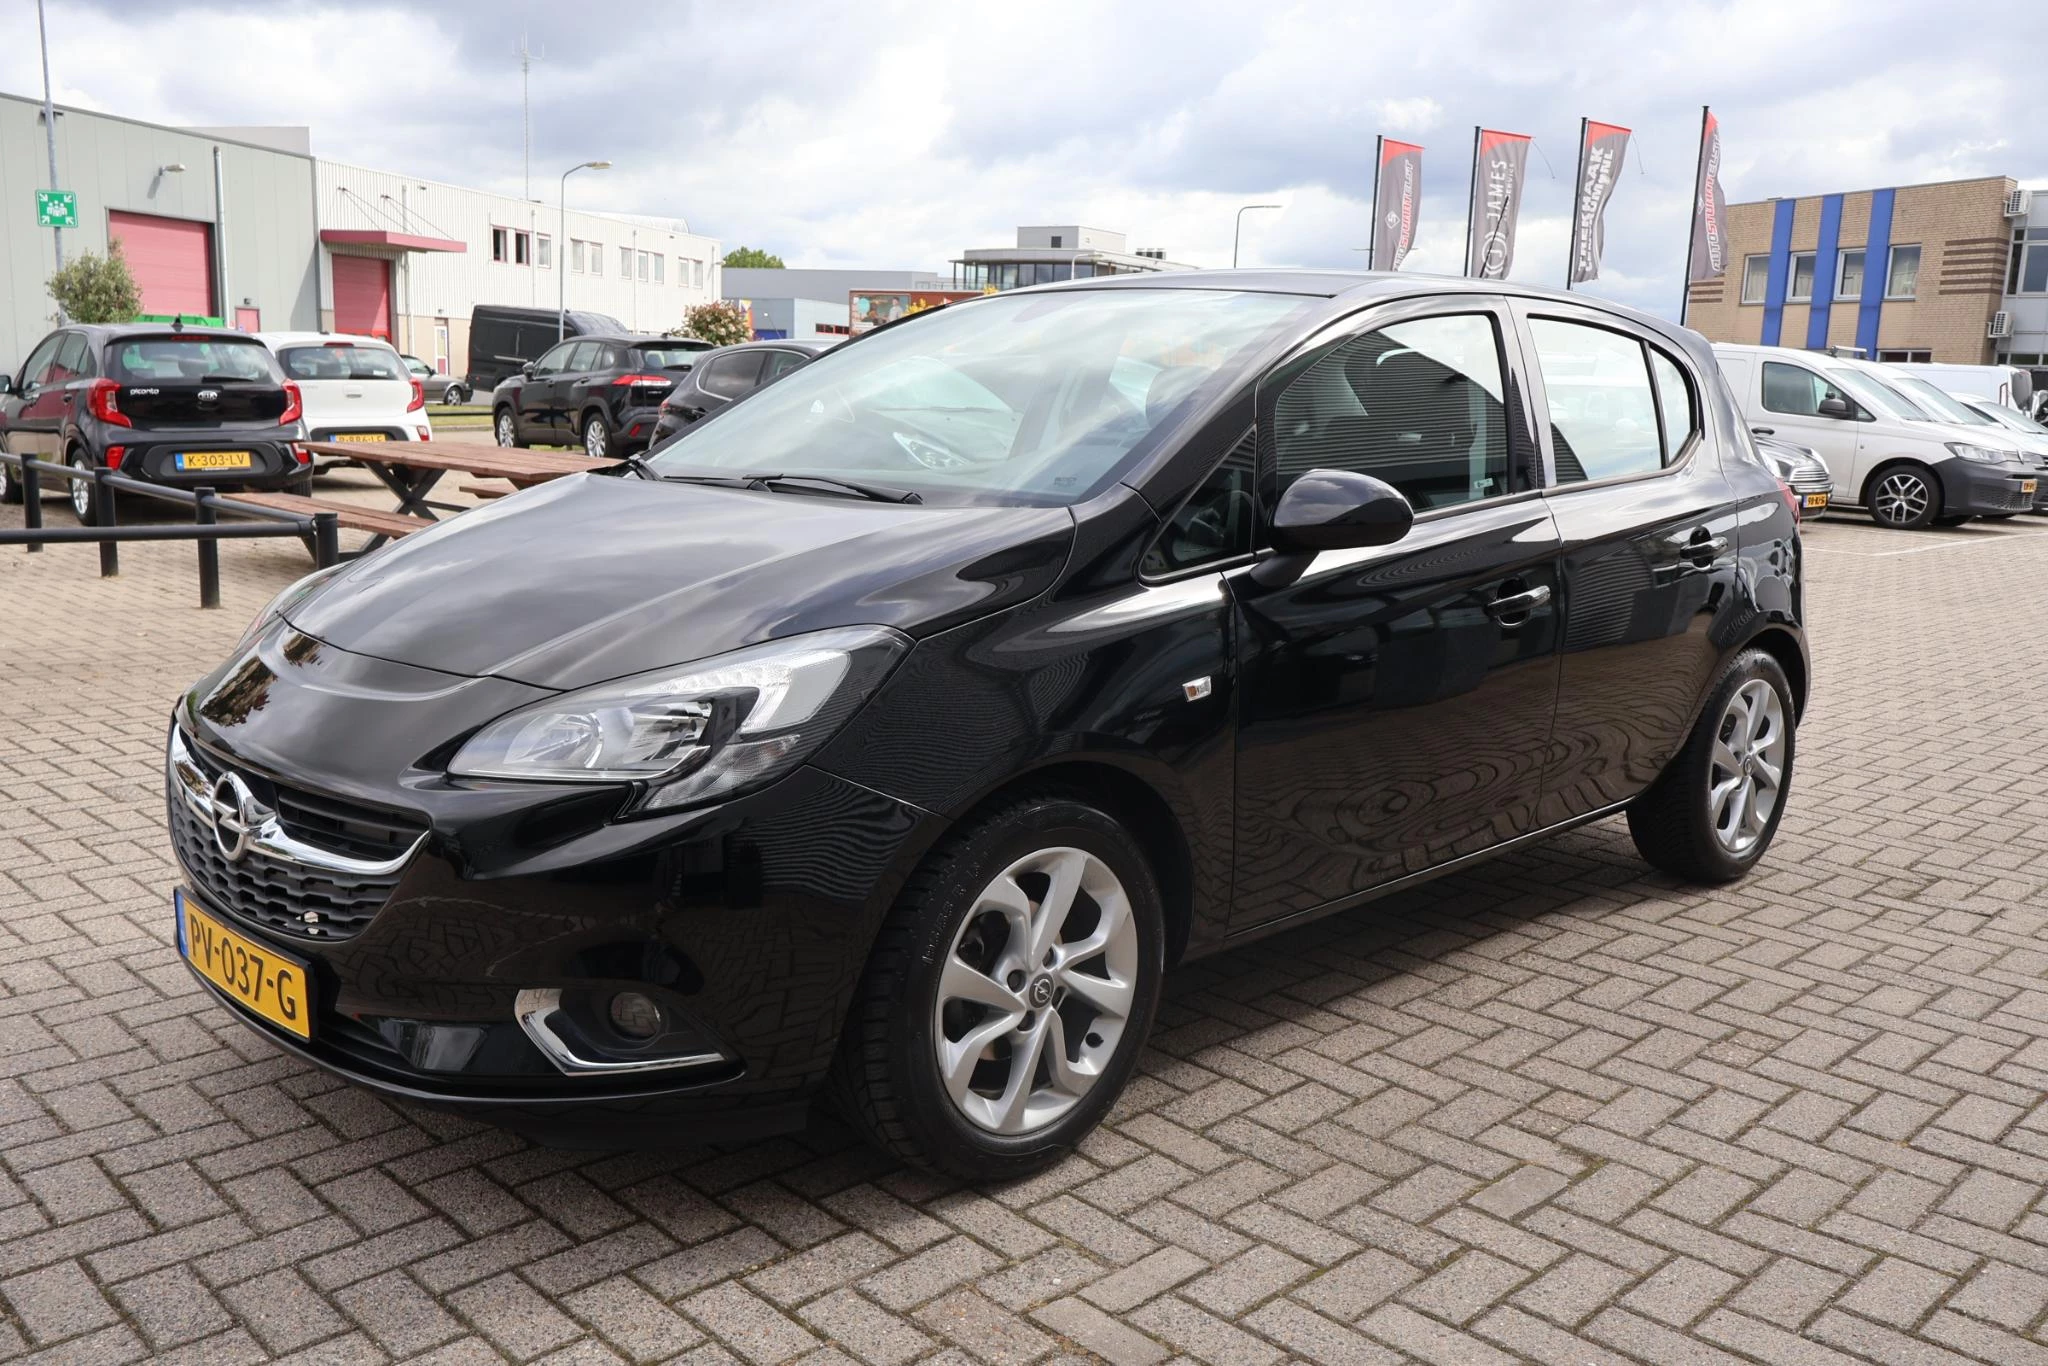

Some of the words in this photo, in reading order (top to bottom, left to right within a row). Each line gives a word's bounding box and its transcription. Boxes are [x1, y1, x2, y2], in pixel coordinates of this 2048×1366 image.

[1486, 159, 1507, 221] JAMES
[129, 387, 160, 396] picanto
[188, 454, 245, 466] K-303-LV
[190, 913, 297, 1021] PV-037-G
